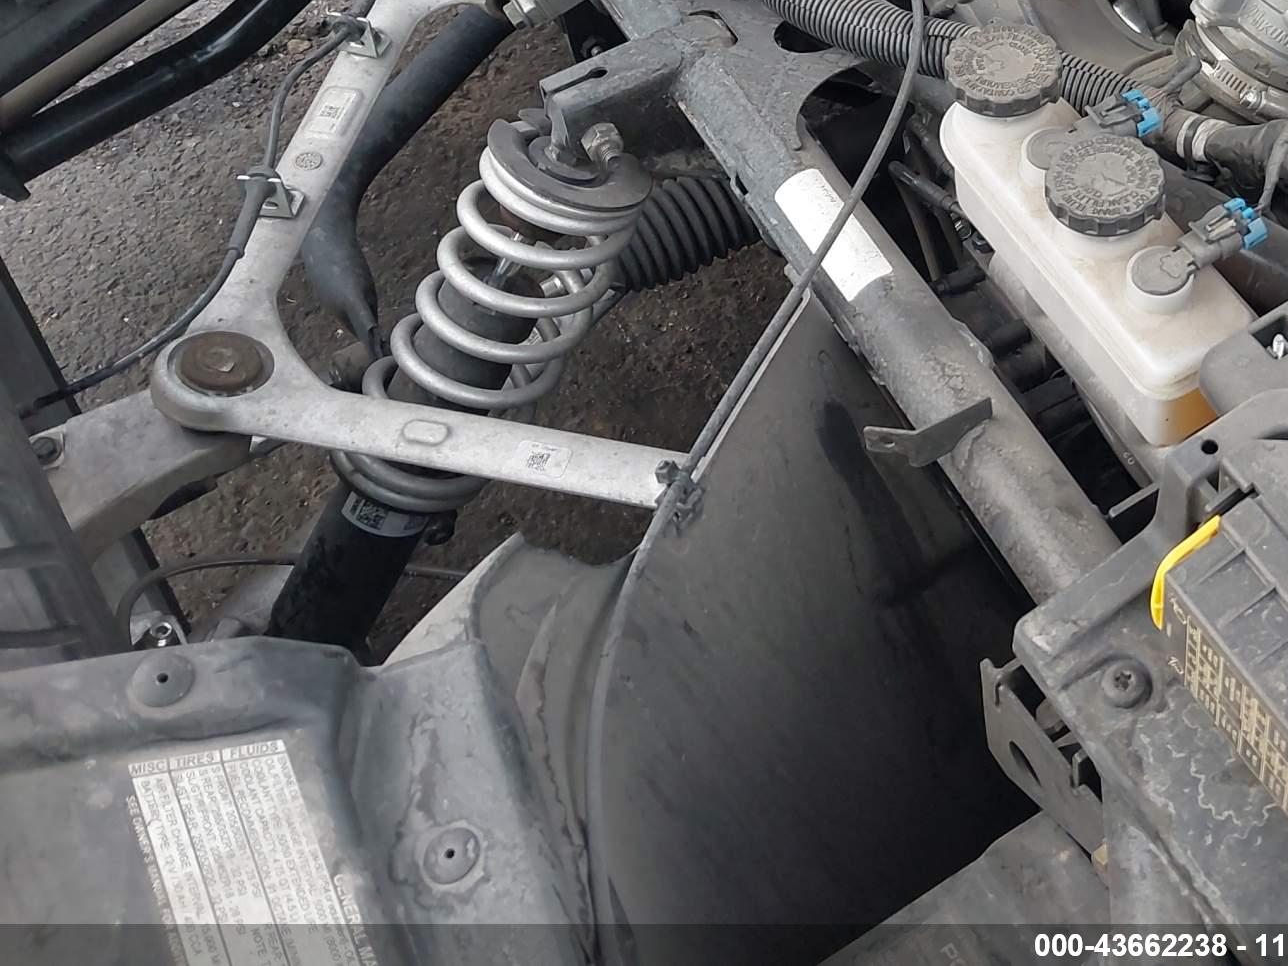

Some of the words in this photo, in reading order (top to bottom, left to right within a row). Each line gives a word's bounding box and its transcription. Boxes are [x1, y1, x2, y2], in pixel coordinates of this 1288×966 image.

[130, 760, 165, 775] MISC
[175, 753, 216, 768] TIRES
[229, 742, 279, 759] FLUIDS
[155, 777, 168, 793] AIR
[237, 761, 261, 805] COOLANT
[125, 794, 140, 816] SEE
[140, 780, 162, 822] BATTERY
[160, 794, 178, 826] FILTER
[170, 828, 192, 869] CHANGE
[249, 758, 274, 803] COOLANT
[284, 858, 312, 911] EXTENDED
[270, 896, 292, 934] OCTANE
[334, 873, 367, 945] GENERAL
